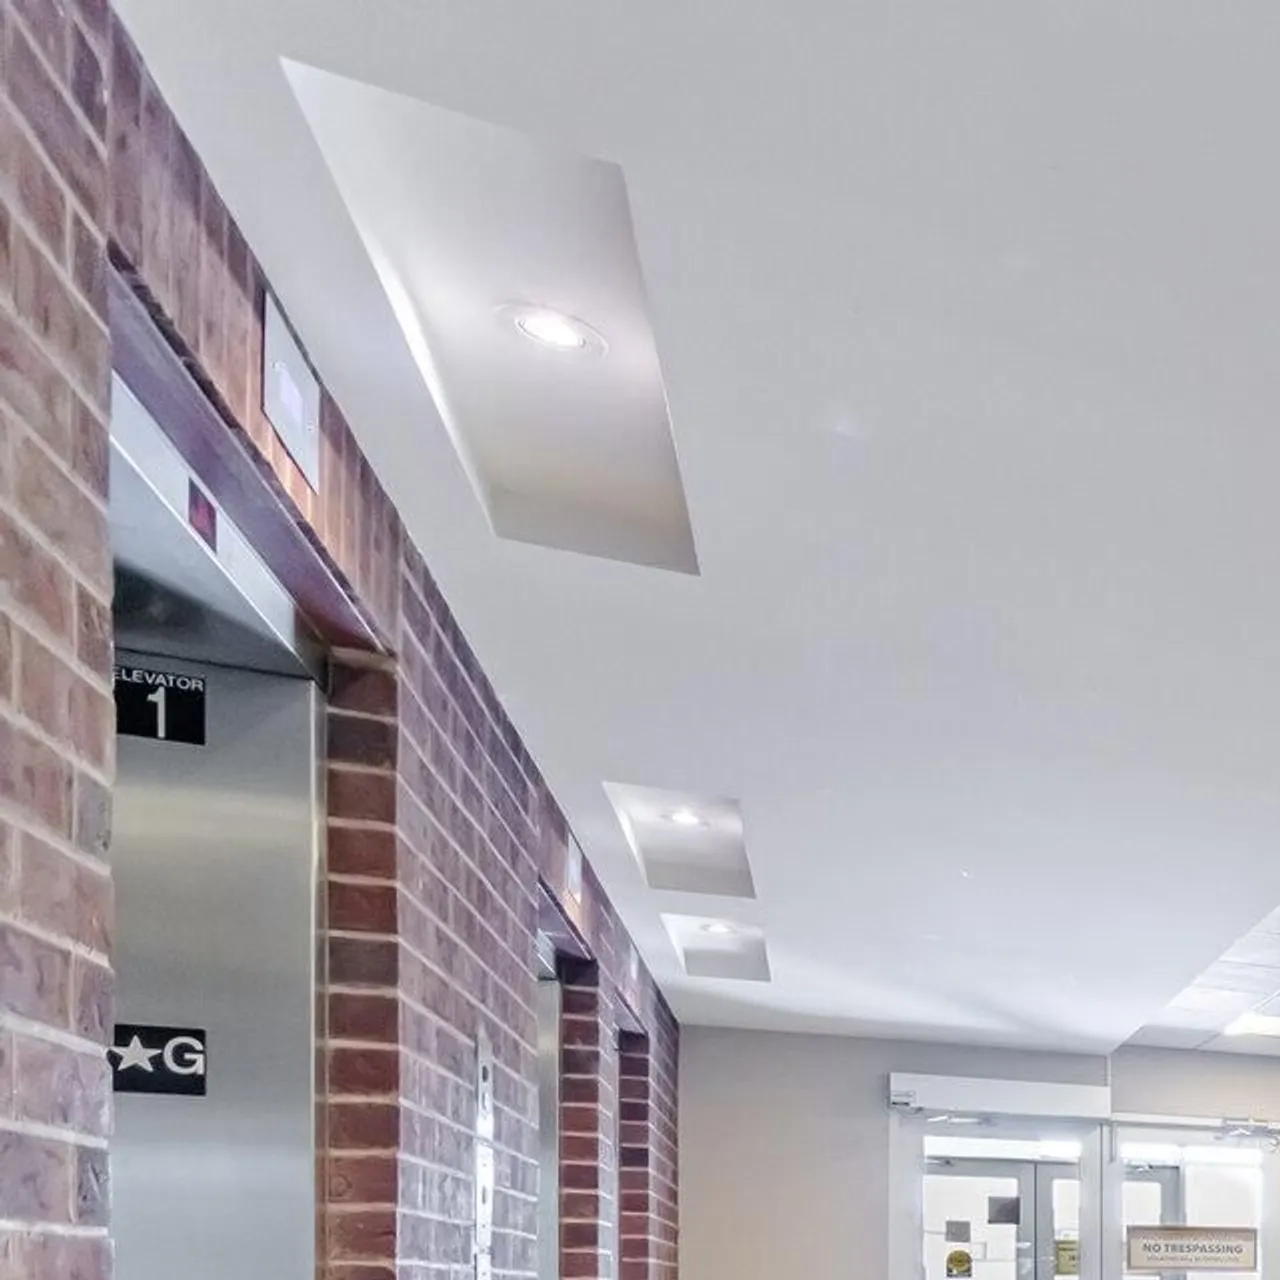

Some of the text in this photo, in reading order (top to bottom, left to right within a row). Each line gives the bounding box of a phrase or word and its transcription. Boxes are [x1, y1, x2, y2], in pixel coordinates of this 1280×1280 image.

[147, 686, 166, 739] 1
[163, 1036, 205, 1075] G
[1142, 1243, 1243, 1254] NO TRESPASSING
